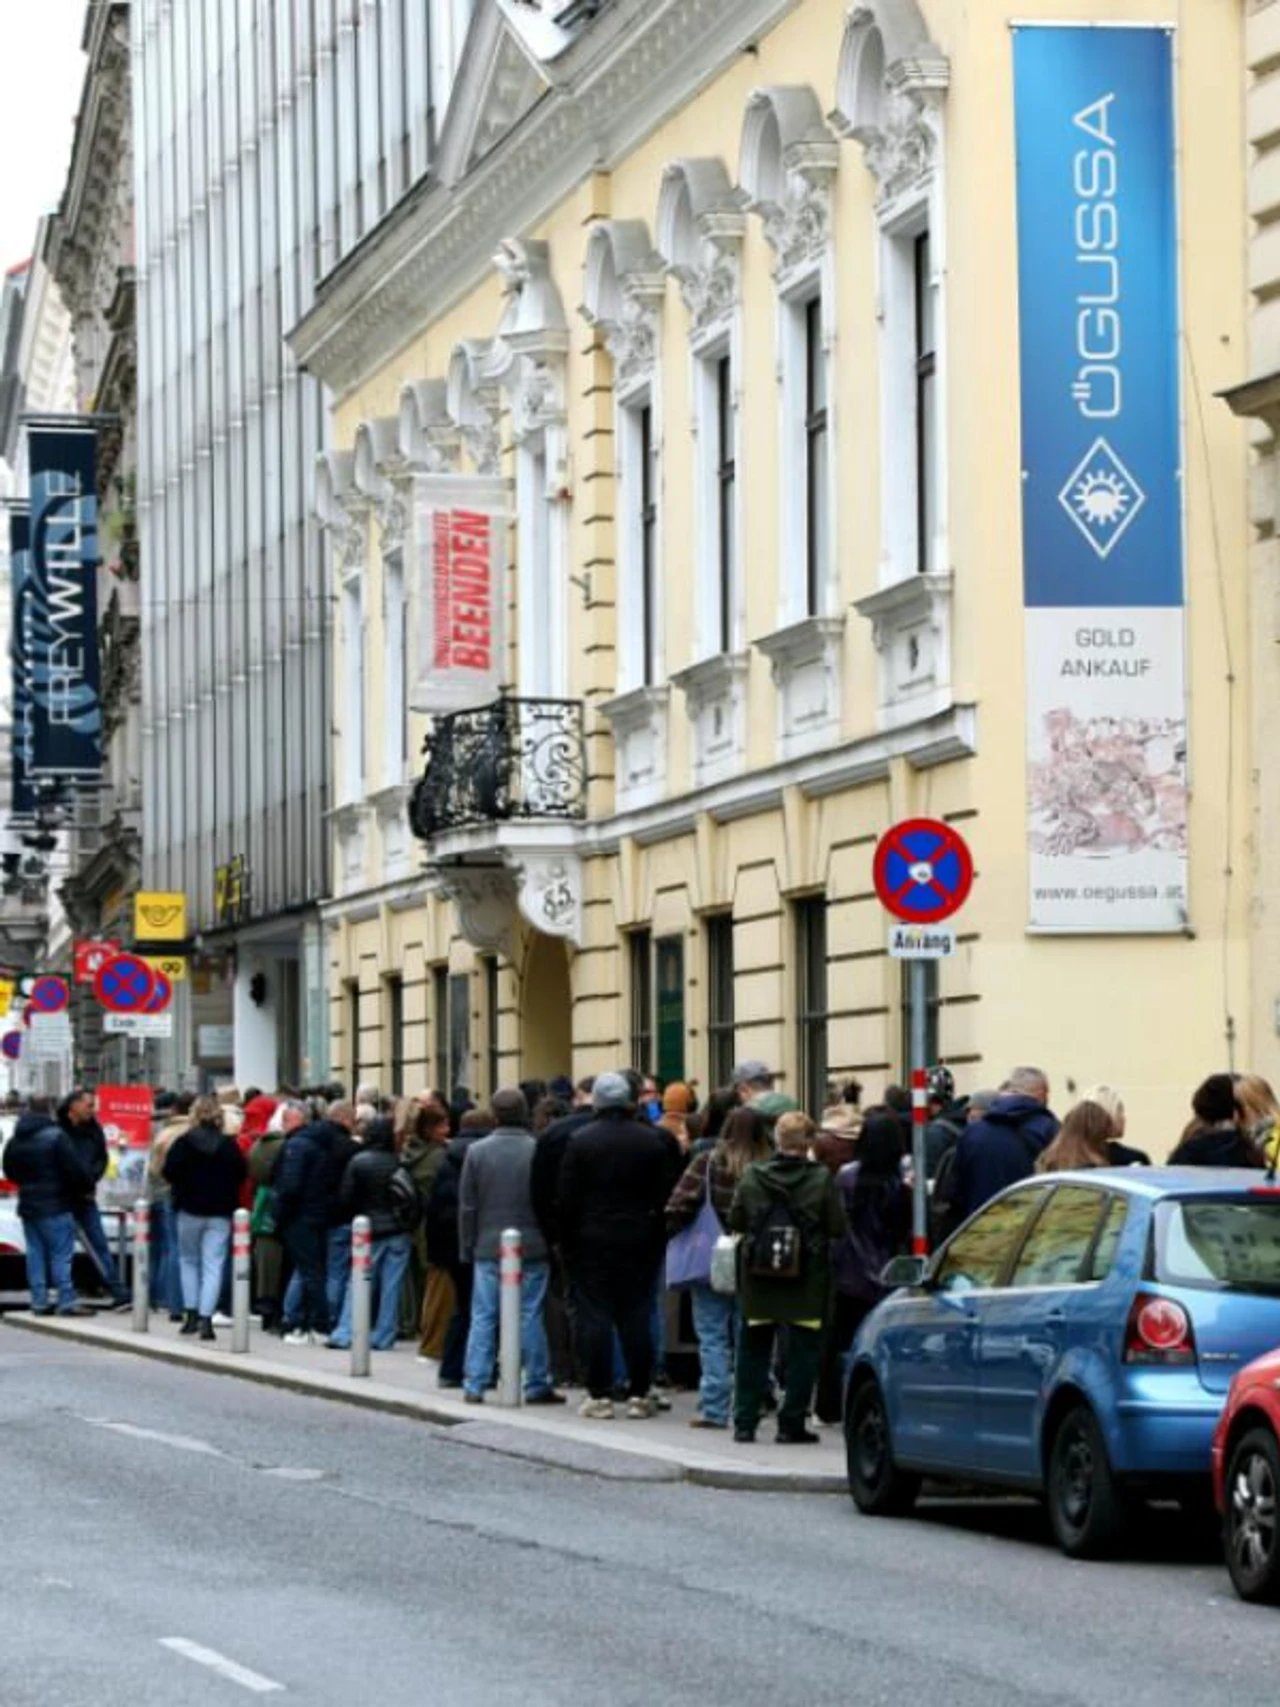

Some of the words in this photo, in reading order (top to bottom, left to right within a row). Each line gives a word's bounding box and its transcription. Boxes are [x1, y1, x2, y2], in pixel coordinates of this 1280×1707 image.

[1071, 92, 1122, 418] ÖGUSSA
[47, 470, 85, 725] FREYWILLE
[452, 510, 491, 670] BEENDEN
[1060, 659, 1152, 677] ANKAUF
[1076, 628, 1134, 647] GOLD
